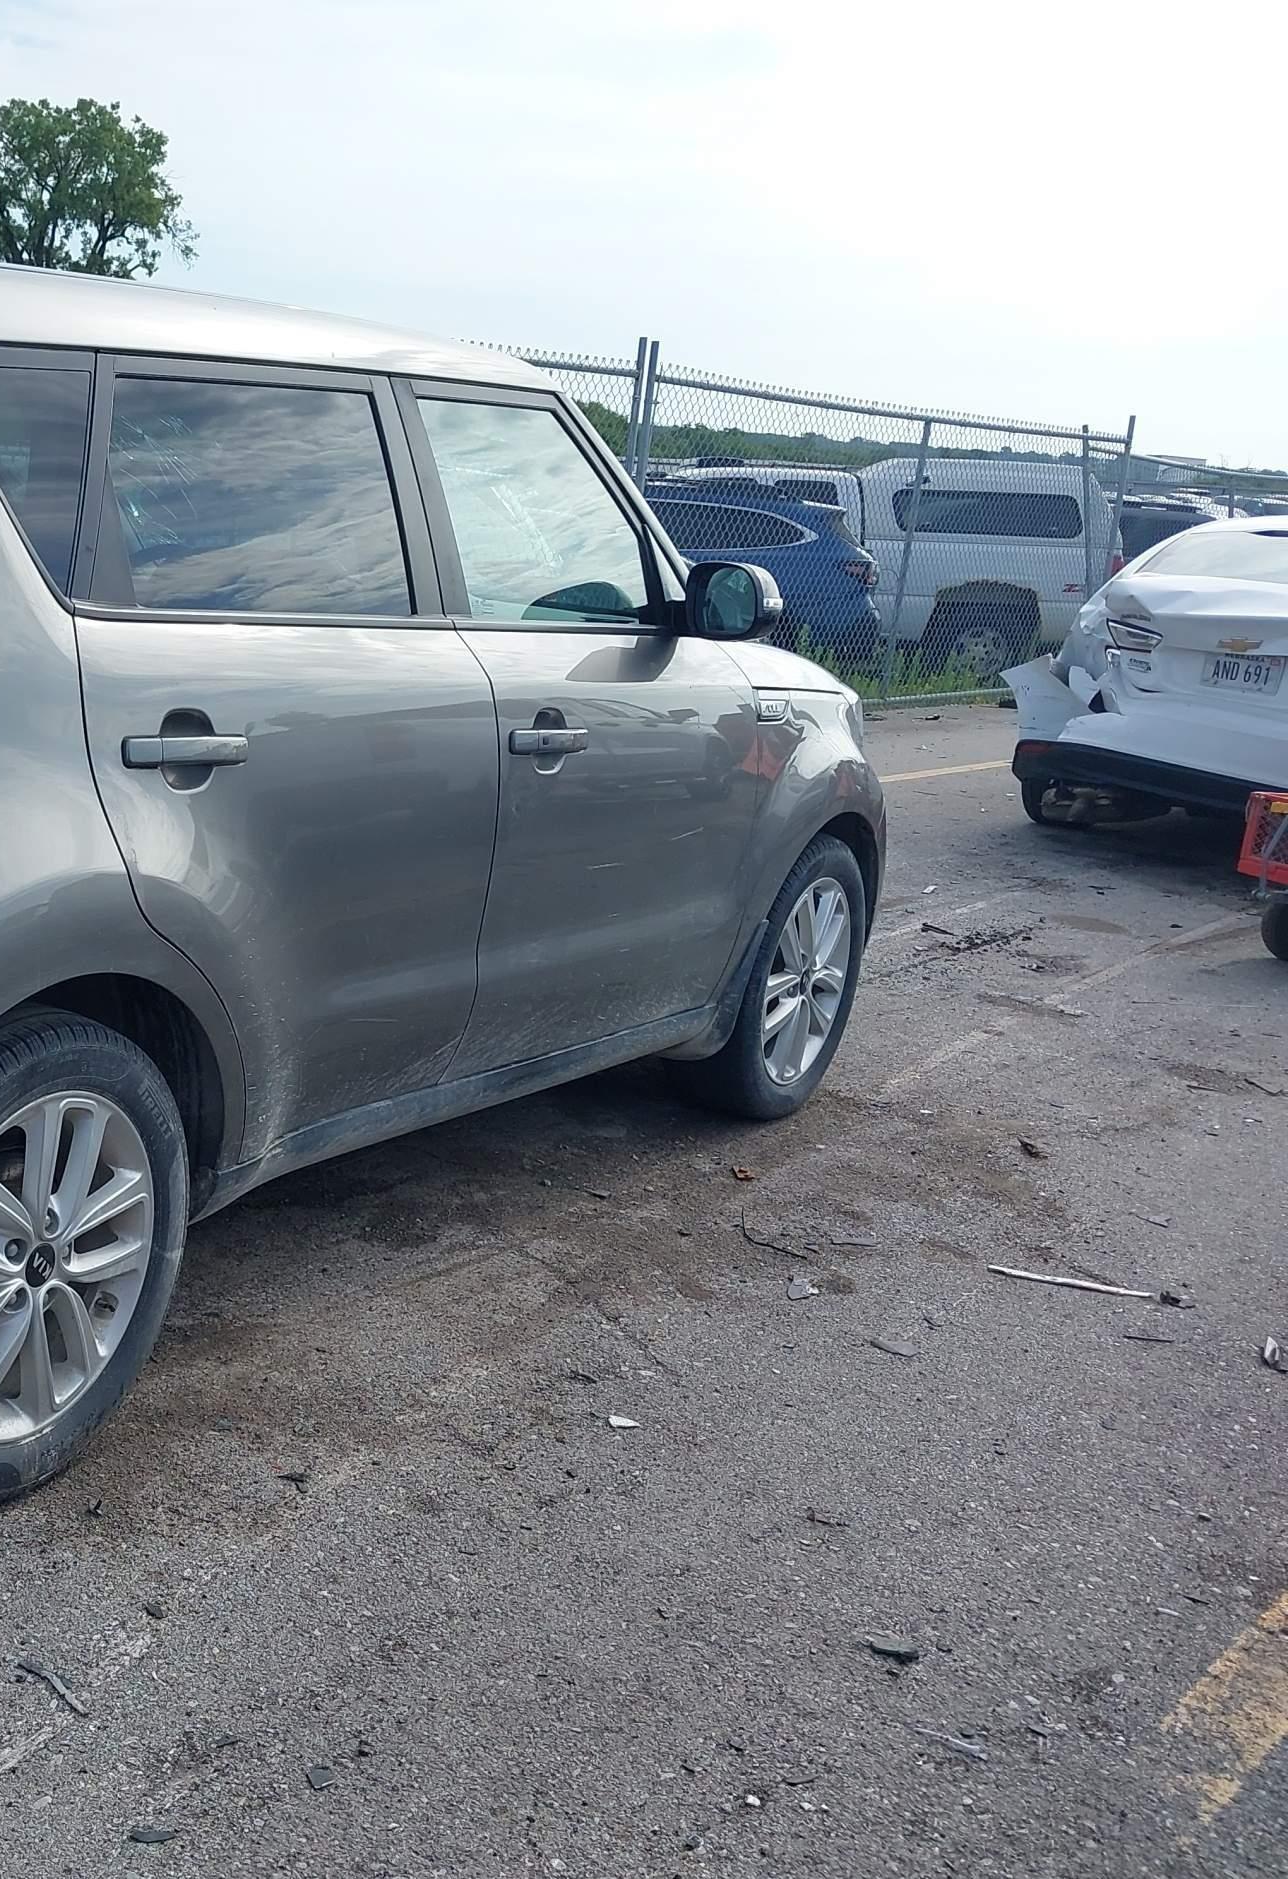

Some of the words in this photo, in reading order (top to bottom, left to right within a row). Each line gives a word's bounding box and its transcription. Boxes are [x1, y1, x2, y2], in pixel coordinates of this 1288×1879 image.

[1212, 659, 1240, 681] AND
[1243, 664, 1271, 686] 691
[33, 1252, 53, 1280] KIA
